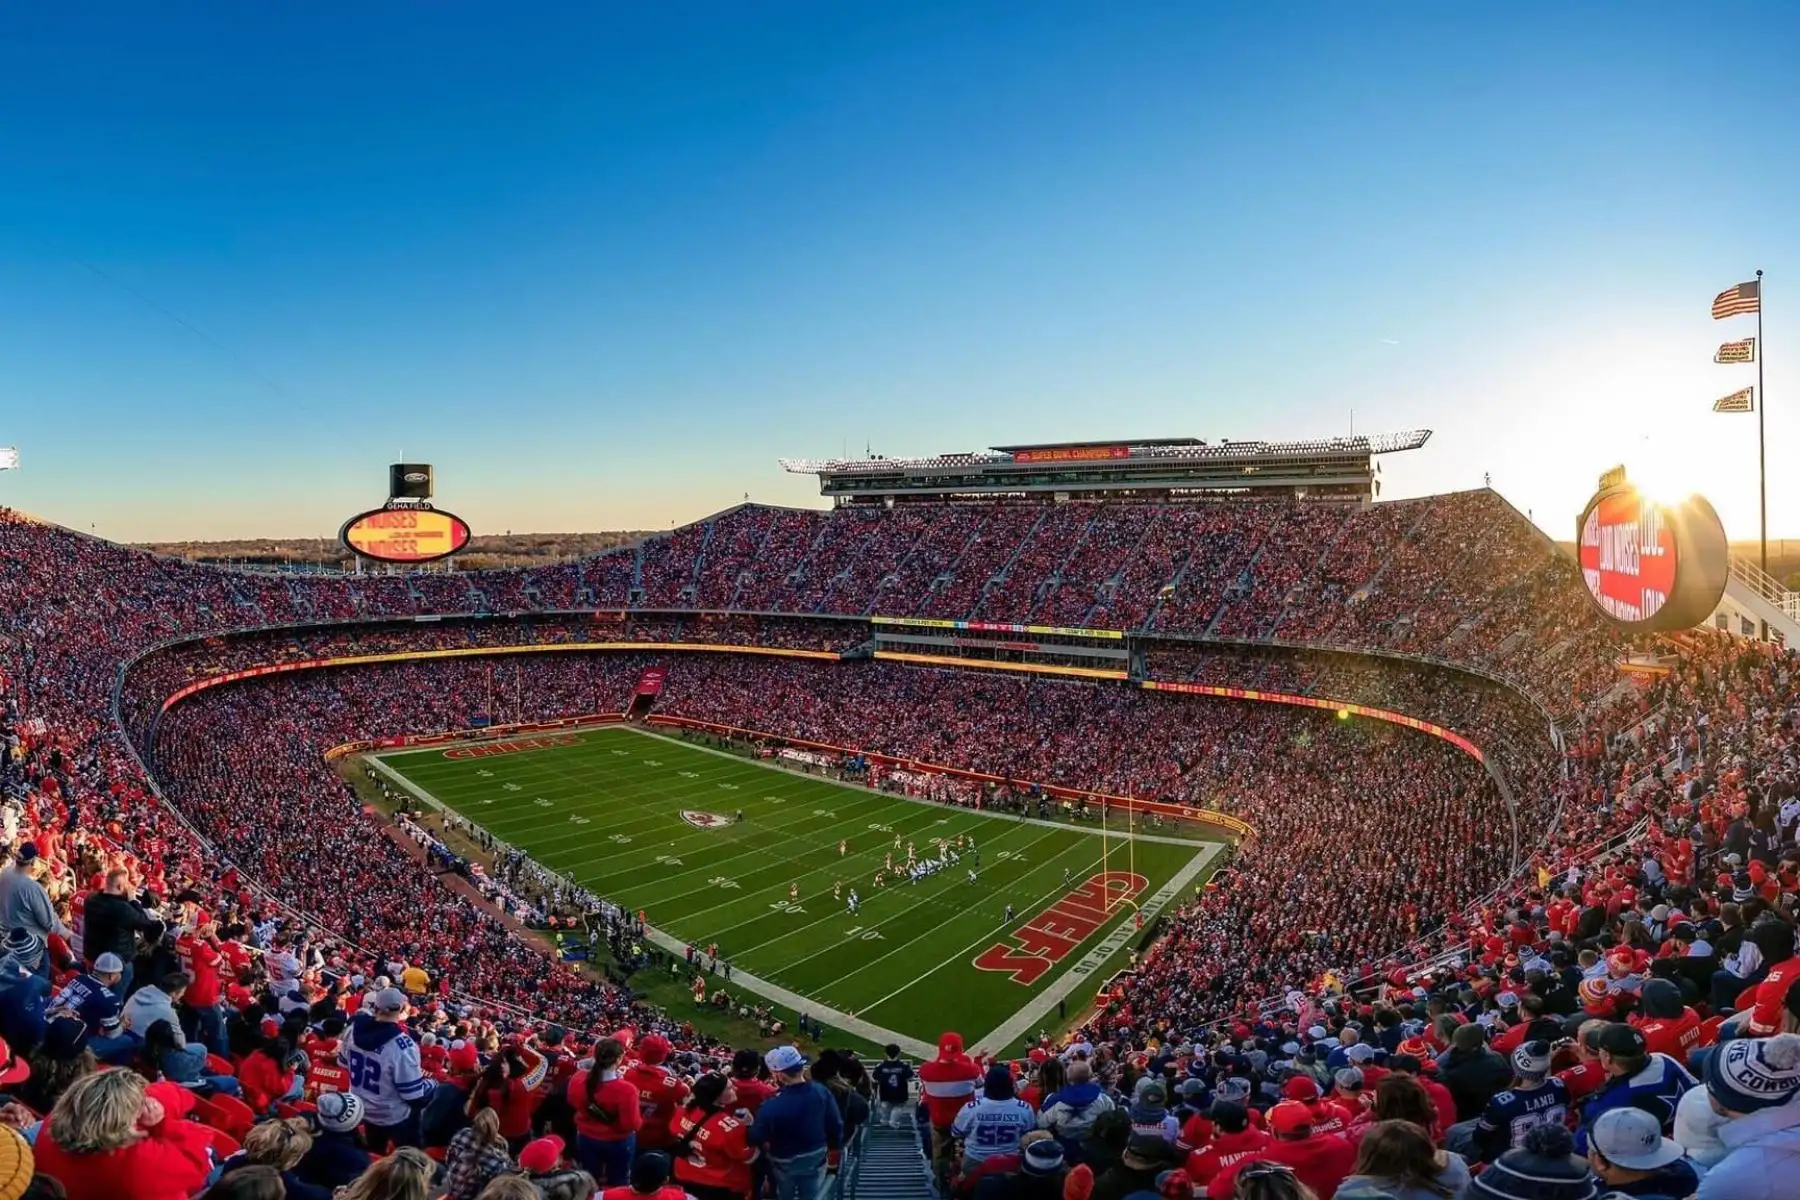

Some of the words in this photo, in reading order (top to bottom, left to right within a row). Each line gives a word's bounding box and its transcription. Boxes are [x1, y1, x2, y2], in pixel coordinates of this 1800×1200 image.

[409, 502, 431, 510] FIELD
[442, 733, 586, 760] CHIEFS
[972, 871, 1149, 986] CHIEFS
[1092, 946, 1112, 959] OF
[1072, 959, 1099, 975] US
[1524, 1094, 1556, 1112] LAMB
[976, 1124, 1019, 1147] 55
